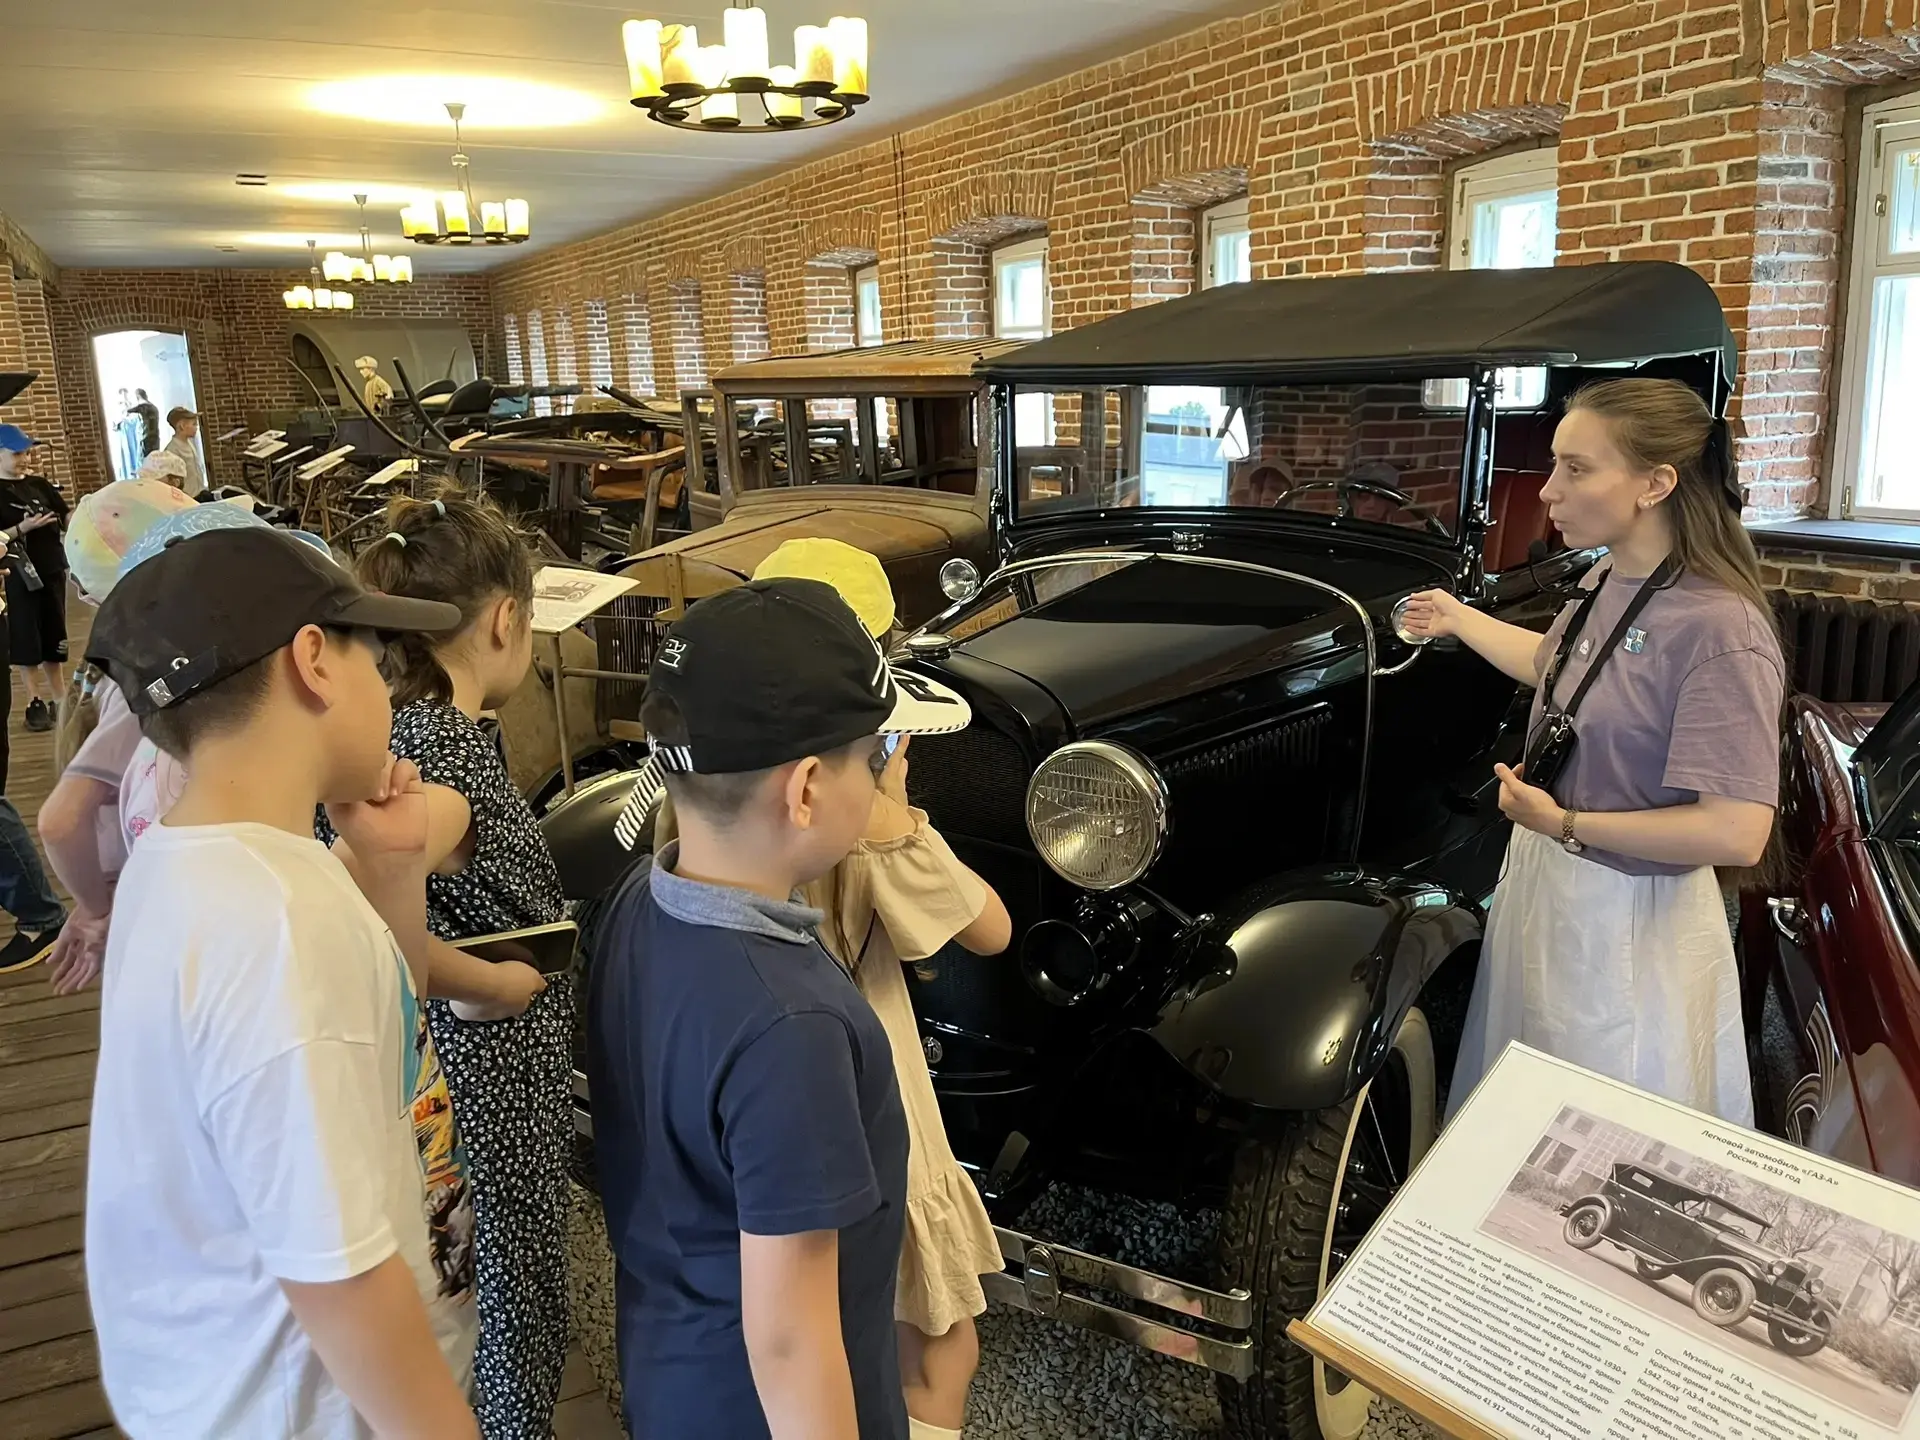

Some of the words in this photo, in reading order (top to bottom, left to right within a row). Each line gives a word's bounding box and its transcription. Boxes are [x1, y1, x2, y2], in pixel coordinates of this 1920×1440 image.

[1701, 1130, 1744, 1150] Легковой
[1744, 1147, 1800, 1172] автомобиль
[1802, 1169, 1839, 1186] «ГАЗ-А»
[1726, 1150, 1759, 1168] Россия,
[1762, 1164, 1784, 1177] 1933
[1785, 1173, 1801, 1185] год
[1386, 1226, 1422, 1247] автомобиль
[1422, 1244, 1443, 1258] марки
[1467, 1266, 1477, 1275] На
[1478, 1272, 1502, 1287] случай
[1501, 1284, 1536, 1304] непогоды
[1542, 1304, 1588, 1332] конструкции
[1588, 1328, 1622, 1347] машины
[1622, 1344, 1639, 1357] был
[1391, 1250, 1409, 1264] ГАЗ-А
[1409, 1260, 1423, 1270] стал
[1423, 1267, 1444, 1281] самой
[1443, 1277, 1476, 1296] массовой
[1475, 1294, 1509, 1314] советской
[1508, 1311, 1542, 1331] легковой
[1540, 1328, 1575, 1348] моделью
[1575, 1346, 1602, 1363] начала
[1603, 1359, 1627, 1376] 1930-х
[1414, 1218, 1432, 1231] ГАЗ-А
[1439, 1231, 1471, 1249] серийный
[1471, 1247, 1502, 1264] легковой
[1503, 1262, 1543, 1284] автомобиль
[1545, 1282, 1577, 1301] среднего
[1579, 1299, 1603, 1314] класса
[1612, 1315, 1650, 1337] открытым
[1448, 1246, 1476, 1262] кузовом
[1480, 1261, 1496, 1272] типа
[1540, 1291, 1583, 1316] прототипом
[1587, 1315, 1622, 1335] которого
[1628, 1335, 1645, 1347] стал
[1480, 1283, 1526, 1310] брезентовым
[1525, 1306, 1550, 1324] тентом
[1327, 1308, 1362, 1331] молодежи)
[1365, 1330, 1387, 1345] общей
[1386, 1342, 1420, 1364] сложности
[1419, 1360, 1438, 1375] было
[1437, 1372, 1482, 1400] произведено
[1482, 1397, 1492, 1406] 41
[1490, 1401, 1506, 1413] 917
[1504, 1410, 1530, 1428] машин
[1338, 1303, 1347, 1311] на
[1346, 1308, 1384, 1332] московском
[1382, 1328, 1406, 1344] заводе
[1405, 1339, 1422, 1353] КИМ
[1420, 1348, 1444, 1367] (завод
[1455, 1368, 1525, 1412] Коммунистического
[1524, 1408, 1581, 1440] интернациона
[1356, 1278, 1382, 1294] правого
[1383, 1291, 1401, 1304] борта
[1403, 1303, 1425, 1318] кузова
[1426, 1315, 1477, 1346] устанавливался
[1479, 1344, 1514, 1368] таксометр
[1523, 1368, 1558, 1391] флажком
[1356, 1300, 1365, 1308] За
[1363, 1305, 1378, 1316] пять
[1377, 1313, 1390, 1322] лет
[1388, 1319, 1416, 1337] выпуска
[1414, 1333, 1454, 1358] (1932-1936)
[1452, 1355, 1462, 1363] на
[1462, 1359, 1507, 1388] Горьковском
[1506, 1385, 1564, 1420] автомобильном
[1564, 1417, 1591, 1436] заводе
[1357, 1267, 1386, 1284] станцией
[1408, 1293, 1430, 1310] Также,
[1430, 1305, 1460, 1324] фаэтоны
[1459, 1321, 1512, 1353] использовались
[1518, 1353, 1550, 1374] качестве
[1549, 1369, 1572, 1387] такси,
[1572, 1383, 1588, 1395] для
[1588, 1391, 1609, 1405] этого
[1366, 1294, 1376, 1304] На
[1375, 1298, 1391, 1311] базе
[1389, 1306, 1408, 1321] ГАЗ-А
[1407, 1317, 1442, 1340] выпускали
[1446, 1339, 1483, 1362] несколько
[1482, 1358, 1503, 1373] типов
[1501, 1370, 1524, 1384] карет
[1522, 1380, 1549, 1400] скорой
[1548, 1395, 1581, 1417] помощи.
[1398, 1277, 1443, 1303] модификация
[1444, 1301, 1483, 1325] оснащалась
[1485, 1323, 1546, 1358] коротковолновой
[1547, 1356, 1587, 1380] войсковой
[1588, 1378, 1615, 1394] радио-
[1420, 1277, 1451, 1296] основном
[1452, 1293, 1510, 1327] государственным
[1511, 1325, 1542, 1344] органам
[1559, 1348, 1592, 1371] Красную
[1594, 1368, 1621, 1385] армию
[1654, 1348, 1712, 1381] Отечественной
[1714, 1379, 1741, 1396] войны
[1743, 1392, 1761, 1406] был
[1612, 1417, 1635, 1433] песка
[1623, 1398, 1673, 1427] десятилетия
[1672, 1423, 1697, 1440] после
[1630, 1387, 1687, 1421] предпринятые
[1636, 1376, 1680, 1404] Калужской
[1686, 1404, 1720, 1426] области,
[1728, 1426, 1743, 1436] где
[1642, 1367, 1662, 1382] 1942
[1660, 1378, 1681, 1393] году
[1681, 1387, 1704, 1405] ГАЗ-А
[1704, 1401, 1752, 1428] вражеским
[1648, 1357, 1682, 1379] Красной
[1682, 1376, 1709, 1394] армии
[1717, 1393, 1753, 1416] качестве
[1682, 1349, 1724, 1374] Музейный
[1729, 1372, 1754, 1391] ГАЗ-А,
[1837, 1425, 1858, 1440] 1933
